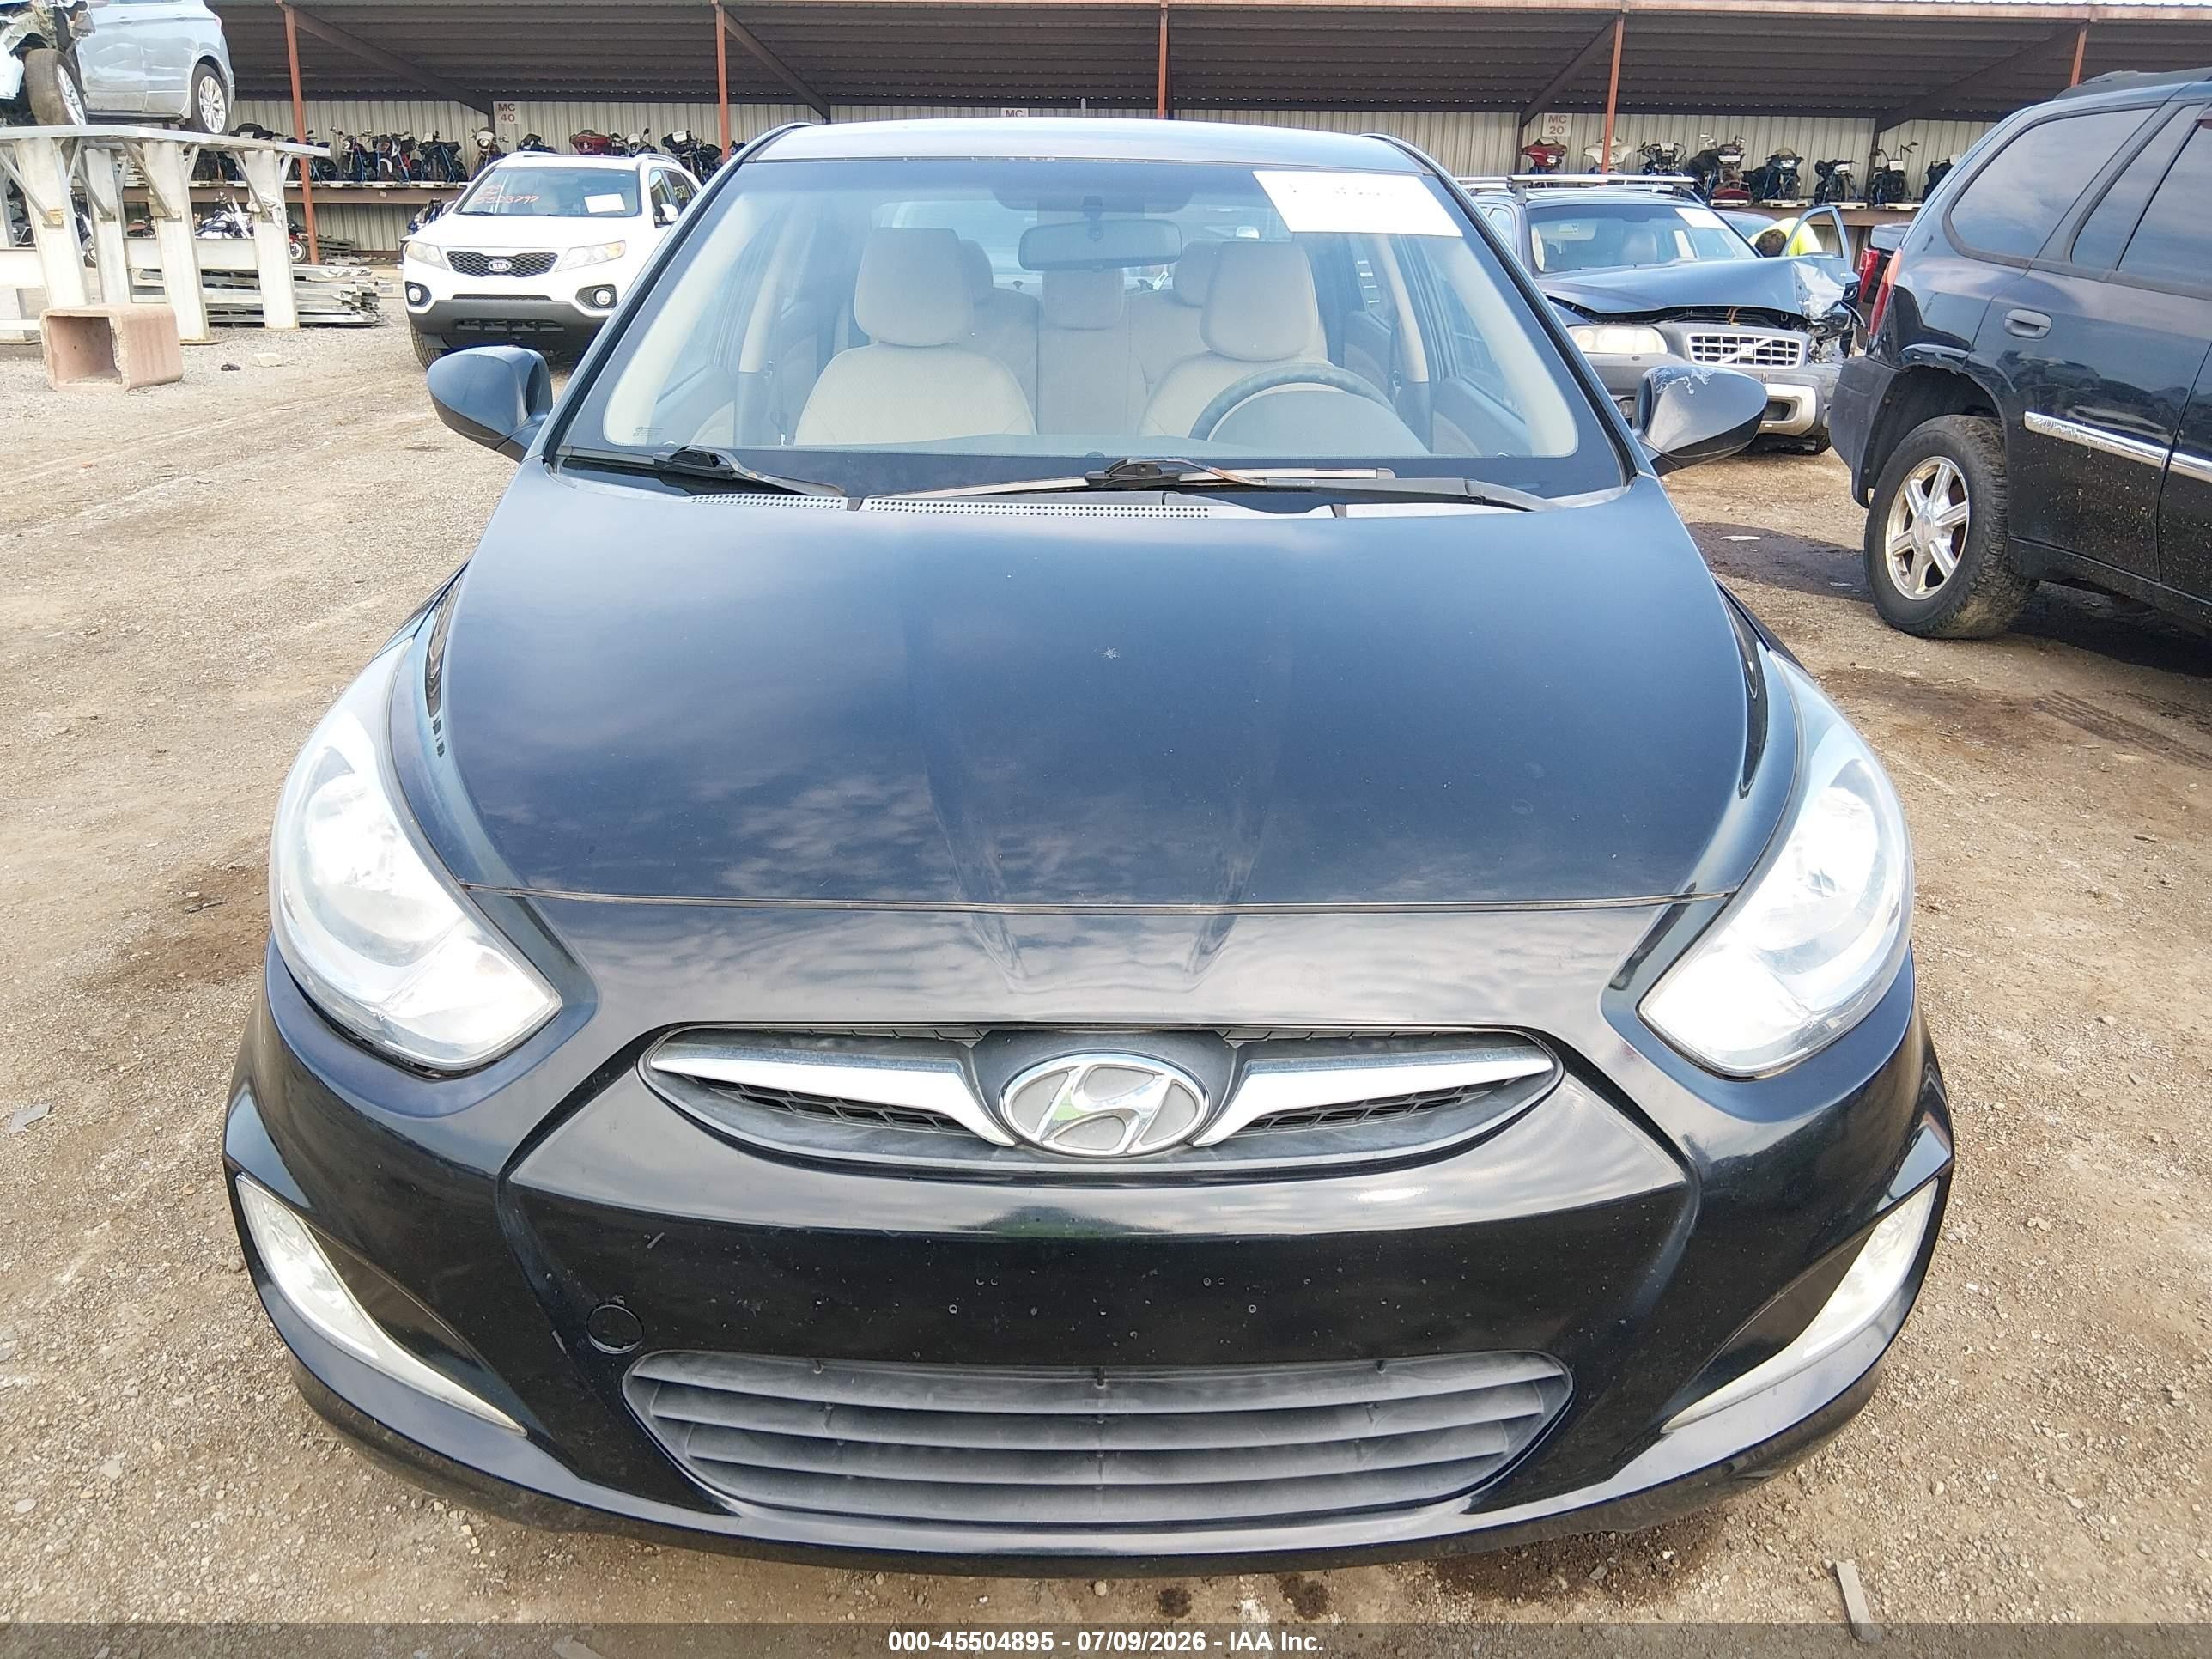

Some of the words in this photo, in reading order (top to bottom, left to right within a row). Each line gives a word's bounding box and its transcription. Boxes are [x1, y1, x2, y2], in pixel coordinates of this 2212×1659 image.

[498, 103, 515, 112] MC
[500, 113, 515, 122] 40
[1006, 109, 1024, 118] MC
[1548, 115, 1567, 124] MC
[1549, 125, 1565, 135] 20
